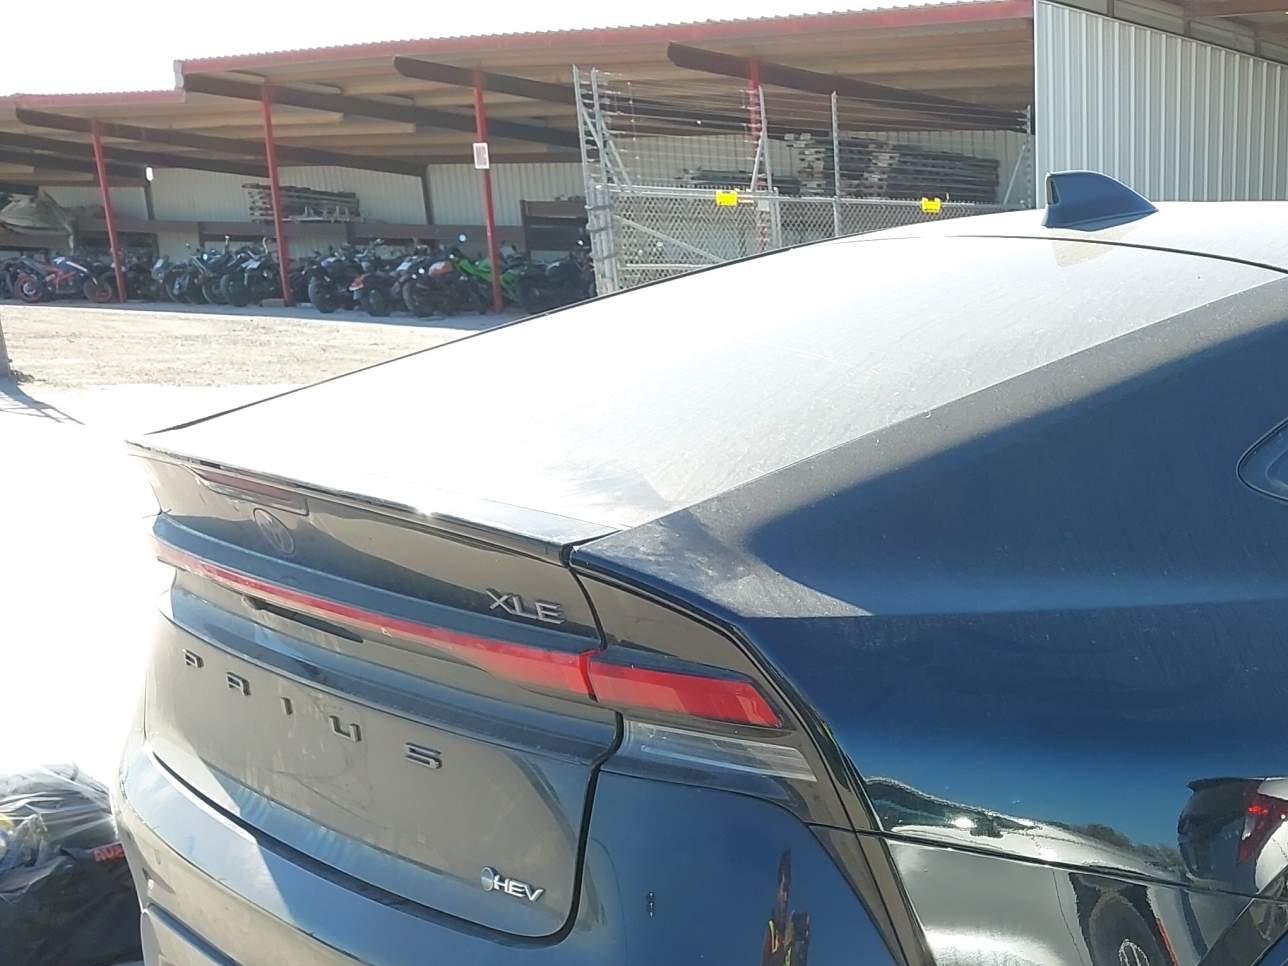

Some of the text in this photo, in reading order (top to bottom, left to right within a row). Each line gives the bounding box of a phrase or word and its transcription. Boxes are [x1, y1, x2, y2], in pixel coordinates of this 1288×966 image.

[486, 588, 566, 625] XLE
[183, 649, 443, 770] PRIUS
[494, 874, 545, 902] HEV
